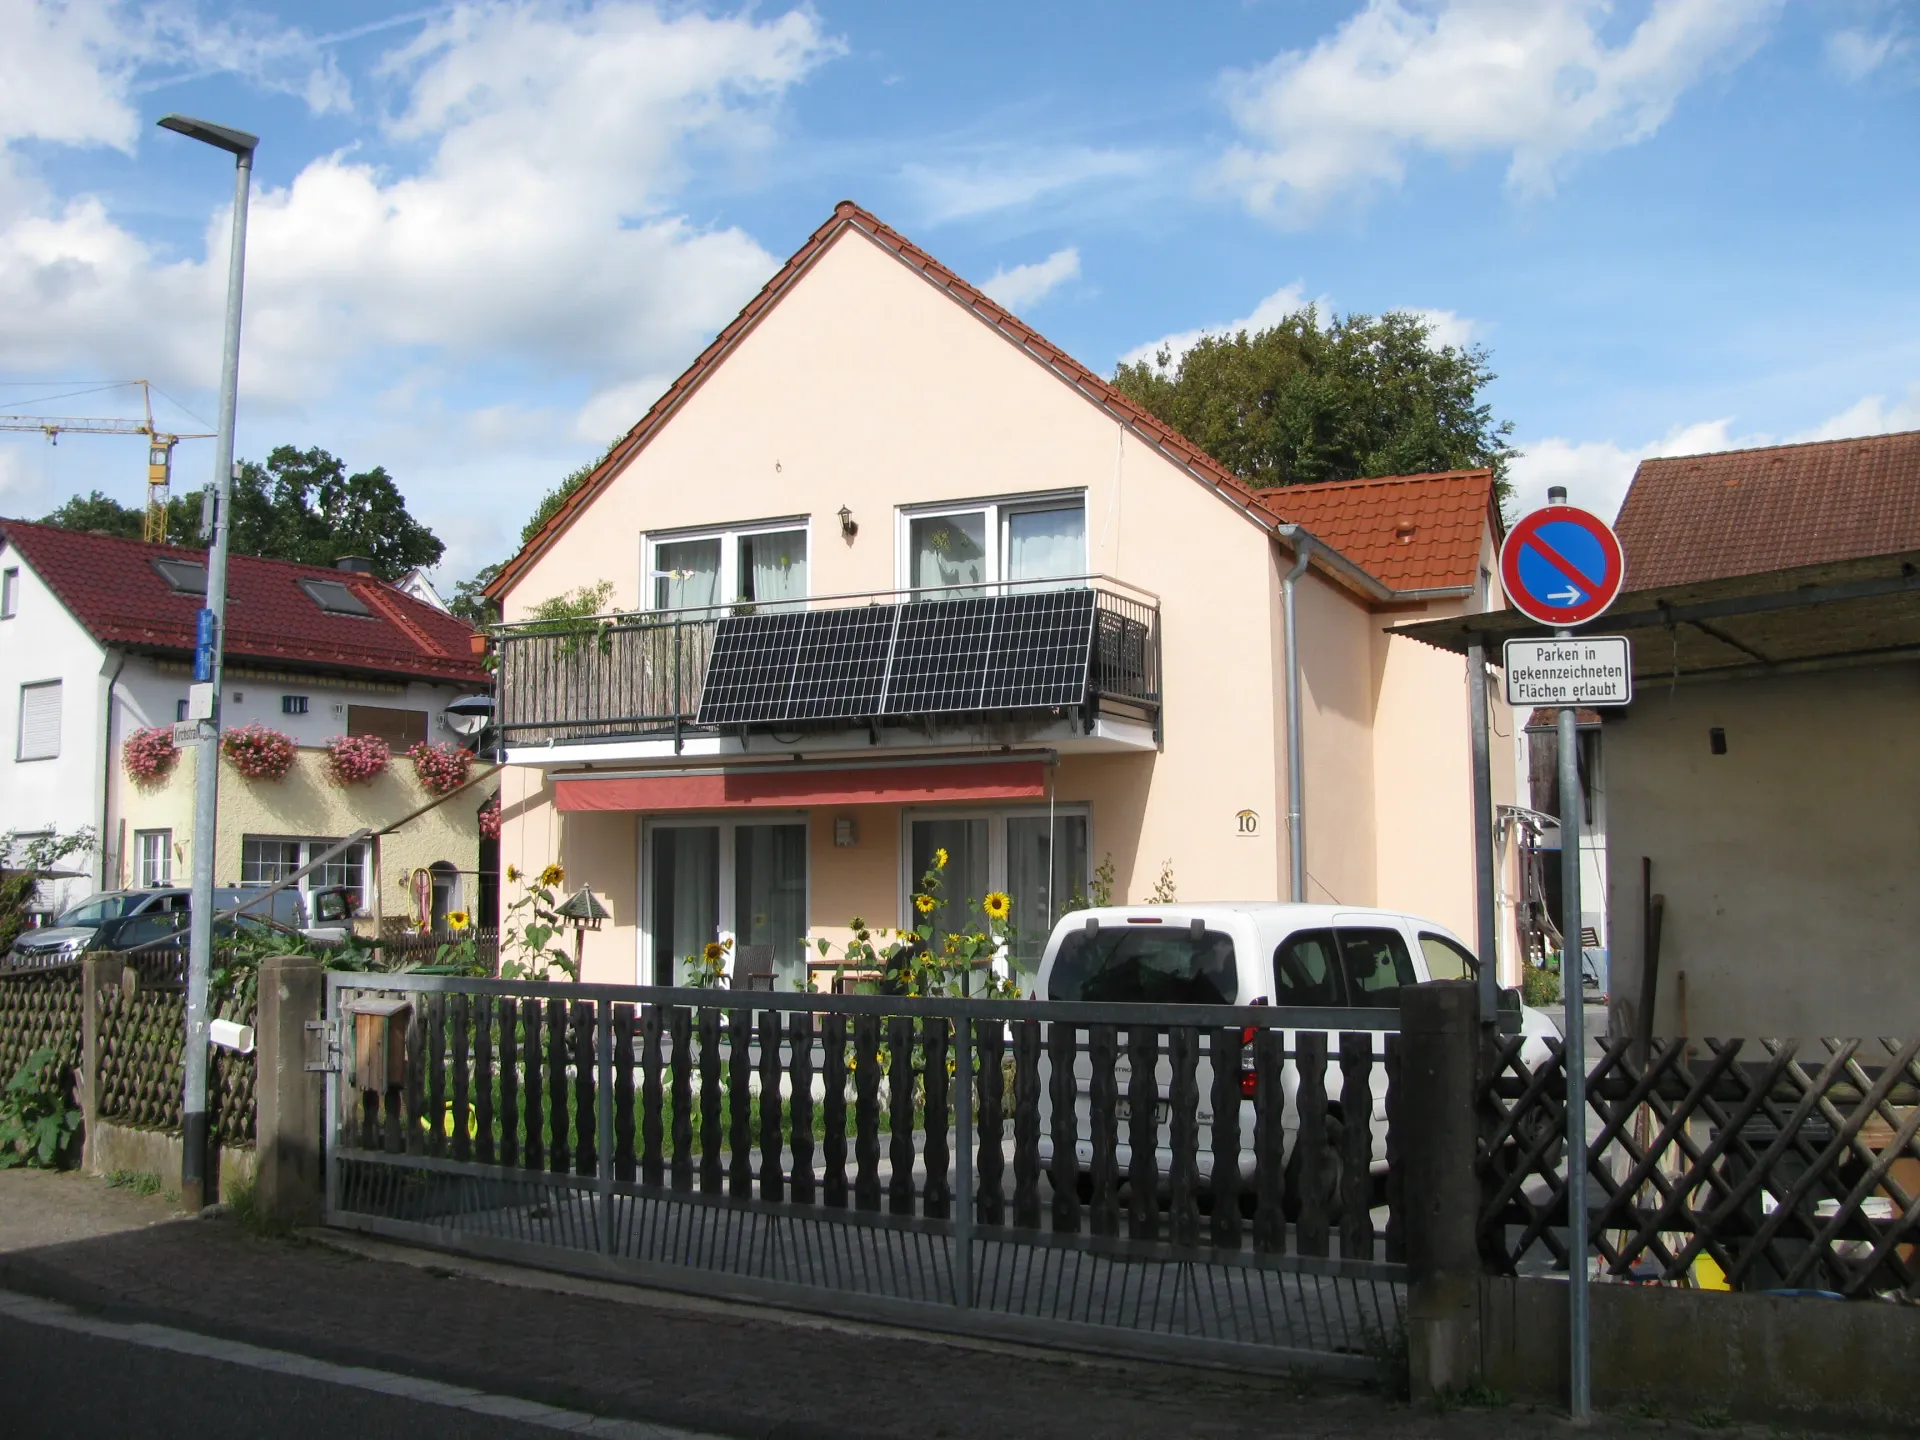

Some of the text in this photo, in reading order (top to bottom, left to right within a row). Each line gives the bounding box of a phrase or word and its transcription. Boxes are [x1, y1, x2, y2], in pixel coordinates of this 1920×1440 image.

[1536, 646, 1596, 661] Parken in
[1512, 664, 1622, 684] gekennzeichneten
[1519, 682, 1617, 698] Flächen erlaubt
[1238, 815, 1257, 833] 10
